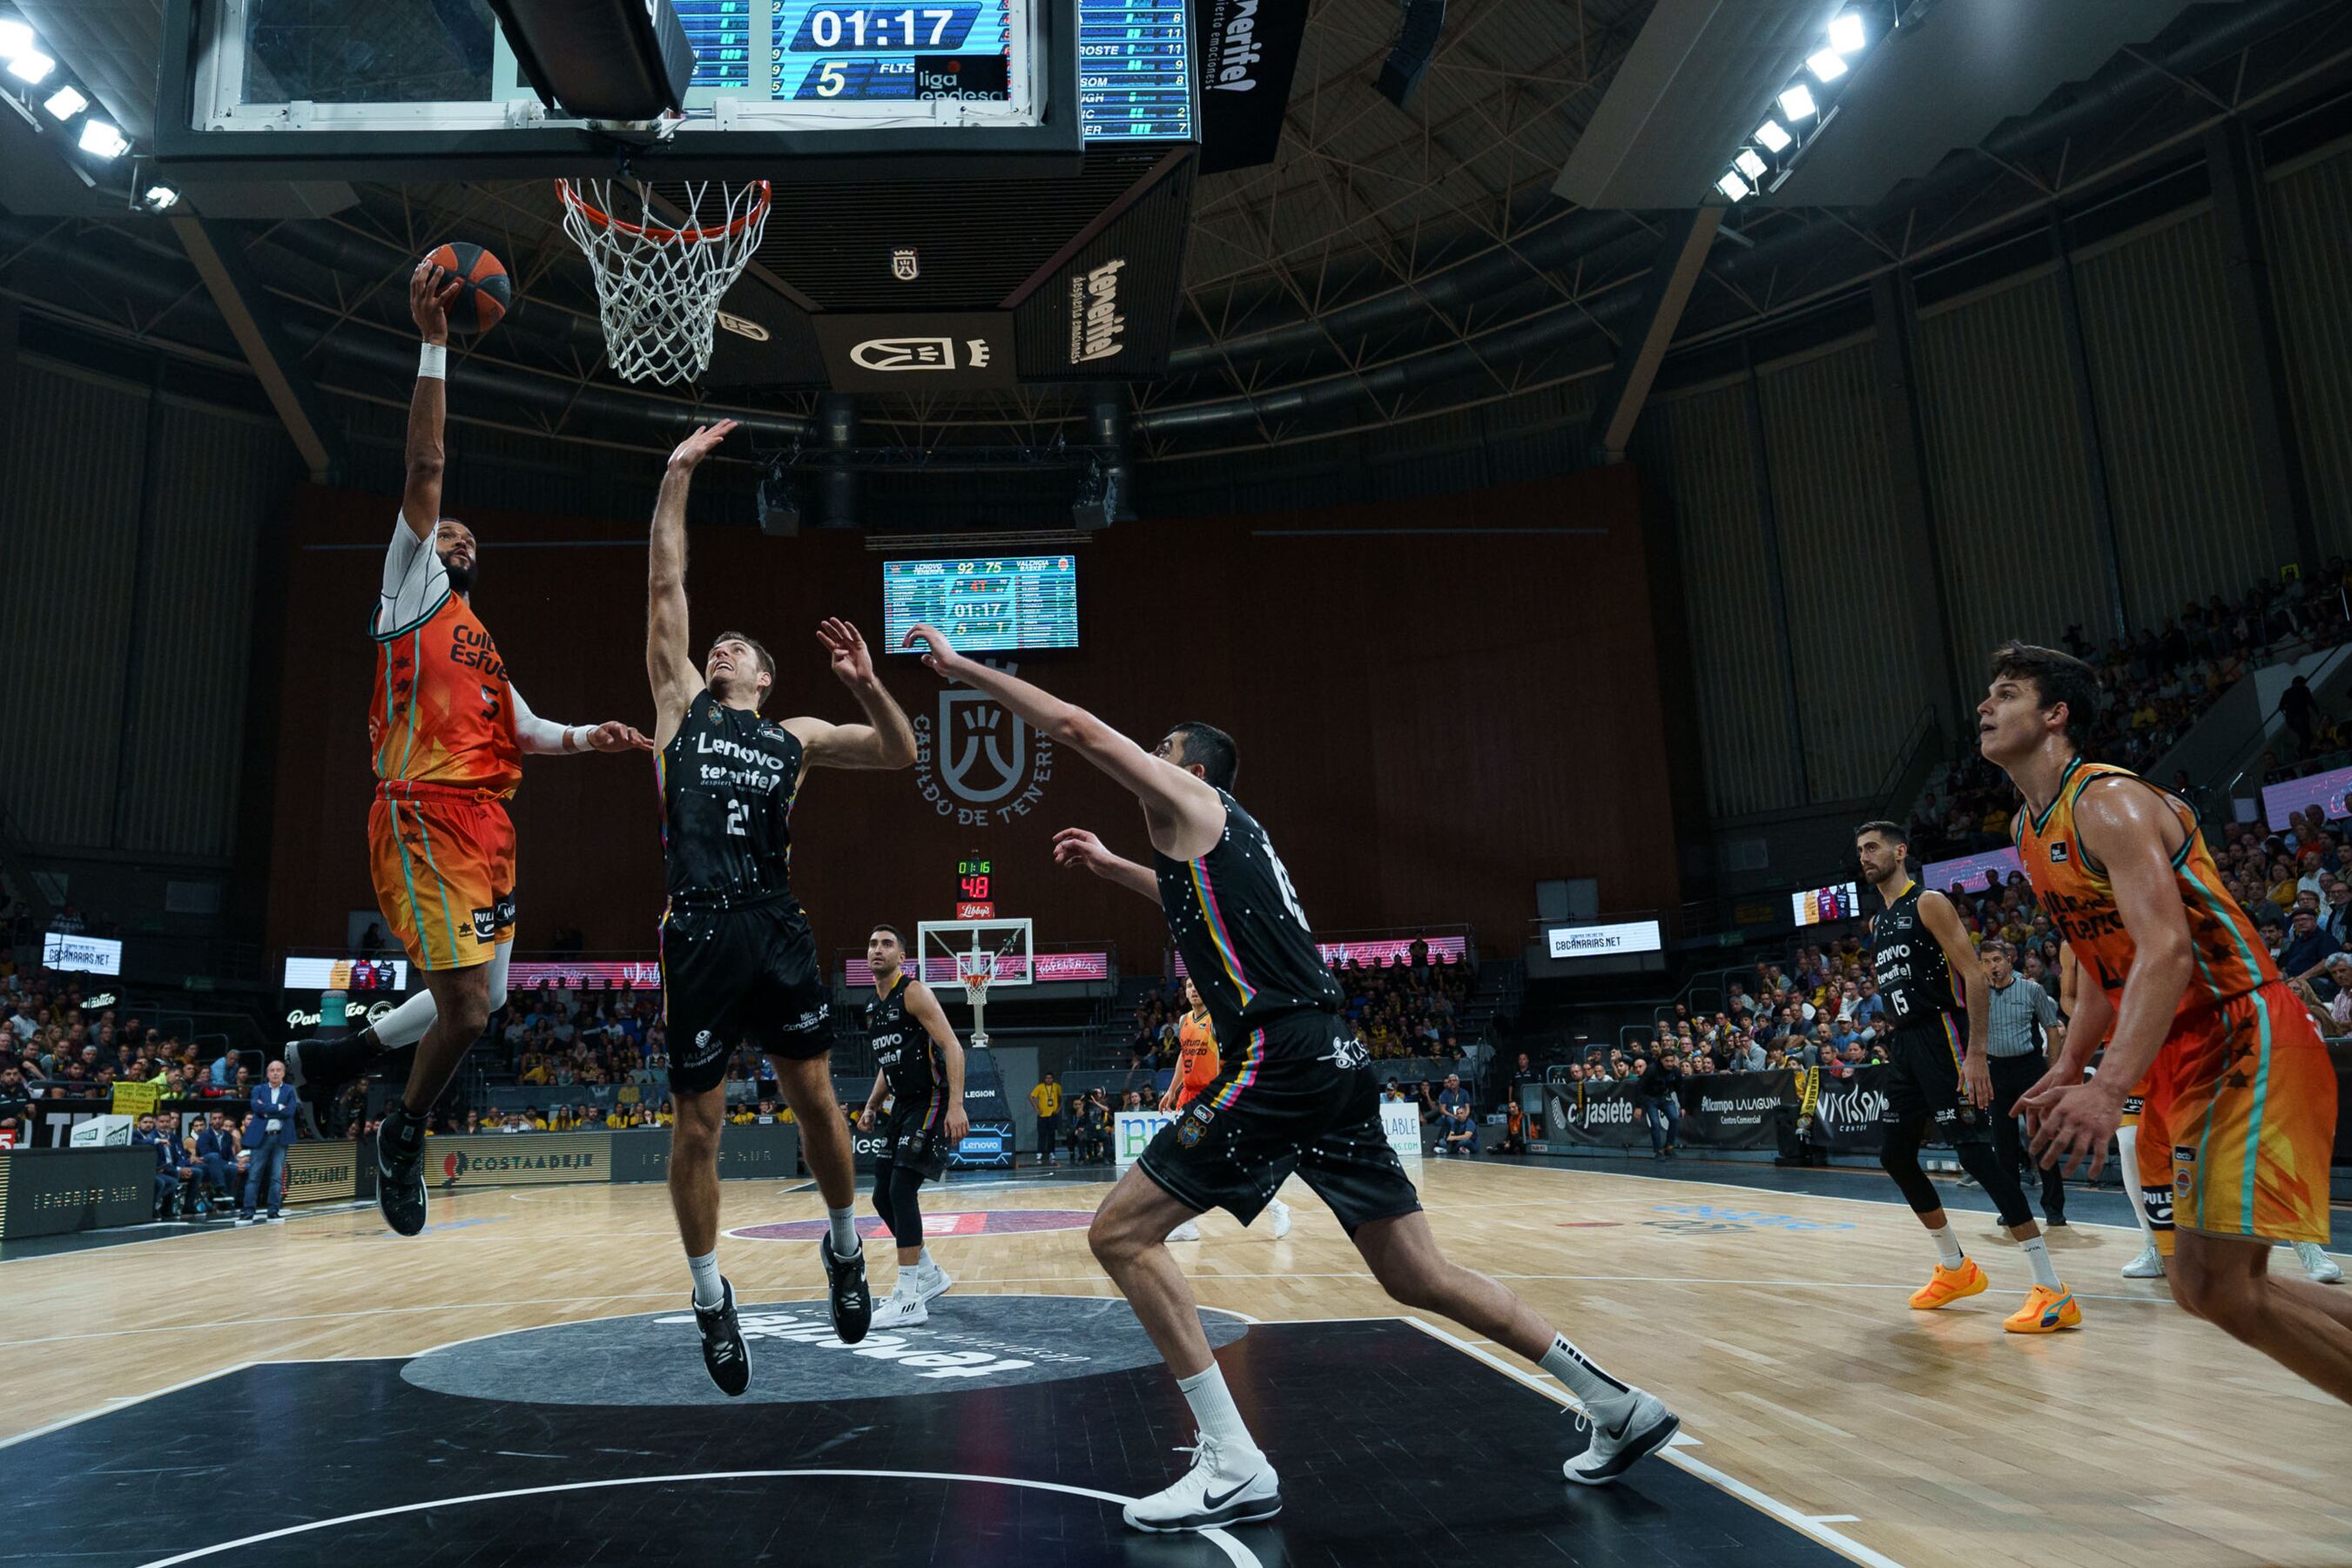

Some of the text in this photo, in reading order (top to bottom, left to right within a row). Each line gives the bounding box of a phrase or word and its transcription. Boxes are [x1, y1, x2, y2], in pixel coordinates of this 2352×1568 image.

[1173, 13, 1181, 23] 8
[812, 10, 953, 47] 01:17
[1167, 29, 1181, 38] 11
[1168, 44, 1182, 54] 11
[1205, 0, 1229, 86] ierta emociones
[1205, 0, 1263, 91] nerife!
[772, 50, 781, 59] 9
[772, 65, 781, 75] 9
[1175, 60, 1183, 70] 9
[772, 81, 780, 91] 5
[817, 62, 914, 97] 5 FLTS
[920, 71, 956, 89] liga
[1080, 76, 1183, 86] SOM 8
[920, 88, 1003, 100] endesa
[1178, 108, 1185, 117] 2
[1082, 124, 1186, 135] ER 7
[1073, 259, 1125, 364] tenerife!
[957, 562, 974, 575] 92
[986, 562, 1002, 573] 75
[970, 581, 987, 593] 4T
[954, 602, 1001, 617] 01:17
[453, 624, 495, 652] Cult
[450, 643, 509, 682] Esfue
[481, 683, 501, 721] 5
[697, 731, 785, 771] Lenovo
[913, 714, 953, 816] CABILDO
[958, 808, 988, 826] DE
[959, 862, 990, 874] 01:16
[961, 904, 990, 919] Libby's
[1890, 988, 1910, 1016] 15
[872, 1033, 903, 1051] enovo
[1184, 1059, 1193, 1073] 9
[964, 1090, 995, 1099] LEGION
[1805, 1067, 1819, 1111] CANARIAS
[1702, 1095, 1734, 1114] Alcampo
[1567, 1096, 1633, 1129] cjasiete
[1721, 1114, 1762, 1125] Centro Comercial
[1382, 1117, 1417, 1135] LABLE
[851, 1134, 882, 1154] les
[962, 1141, 999, 1150] Lenovo
[1392, 1142, 1418, 1151] AS.COM
[2175, 1150, 2192, 1161] acb
[2142, 1191, 2173, 1205] PULE
